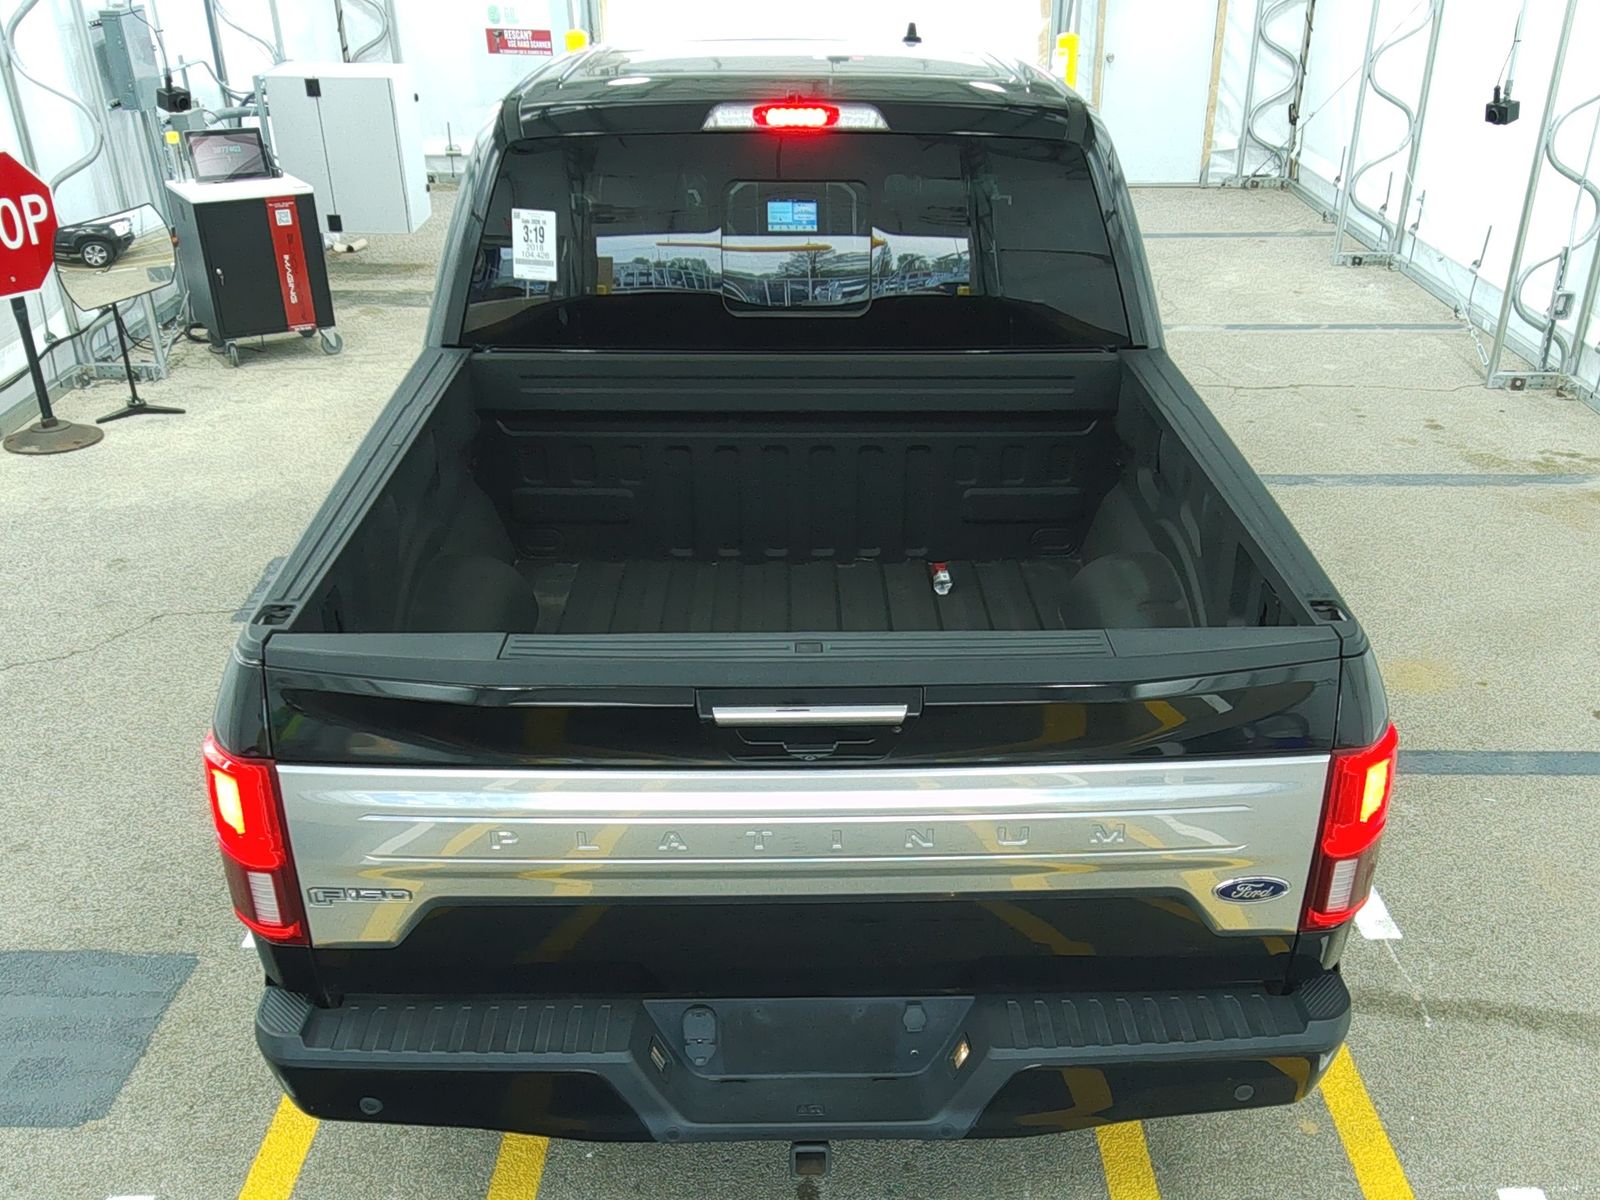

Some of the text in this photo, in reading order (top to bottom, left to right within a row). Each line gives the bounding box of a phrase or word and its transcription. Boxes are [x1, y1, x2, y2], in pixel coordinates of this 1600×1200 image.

[504, 29, 532, 40] RESCAN?
[530, 41, 551, 49] SCANNER
[0, 194, 48, 250] OP
[523, 225, 545, 244] 3:19
[526, 243, 544, 252] 2018
[283, 254, 298, 304] IMAGING
[489, 823, 1126, 851] PLATINUM
[1231, 883, 1275, 899] Ford
